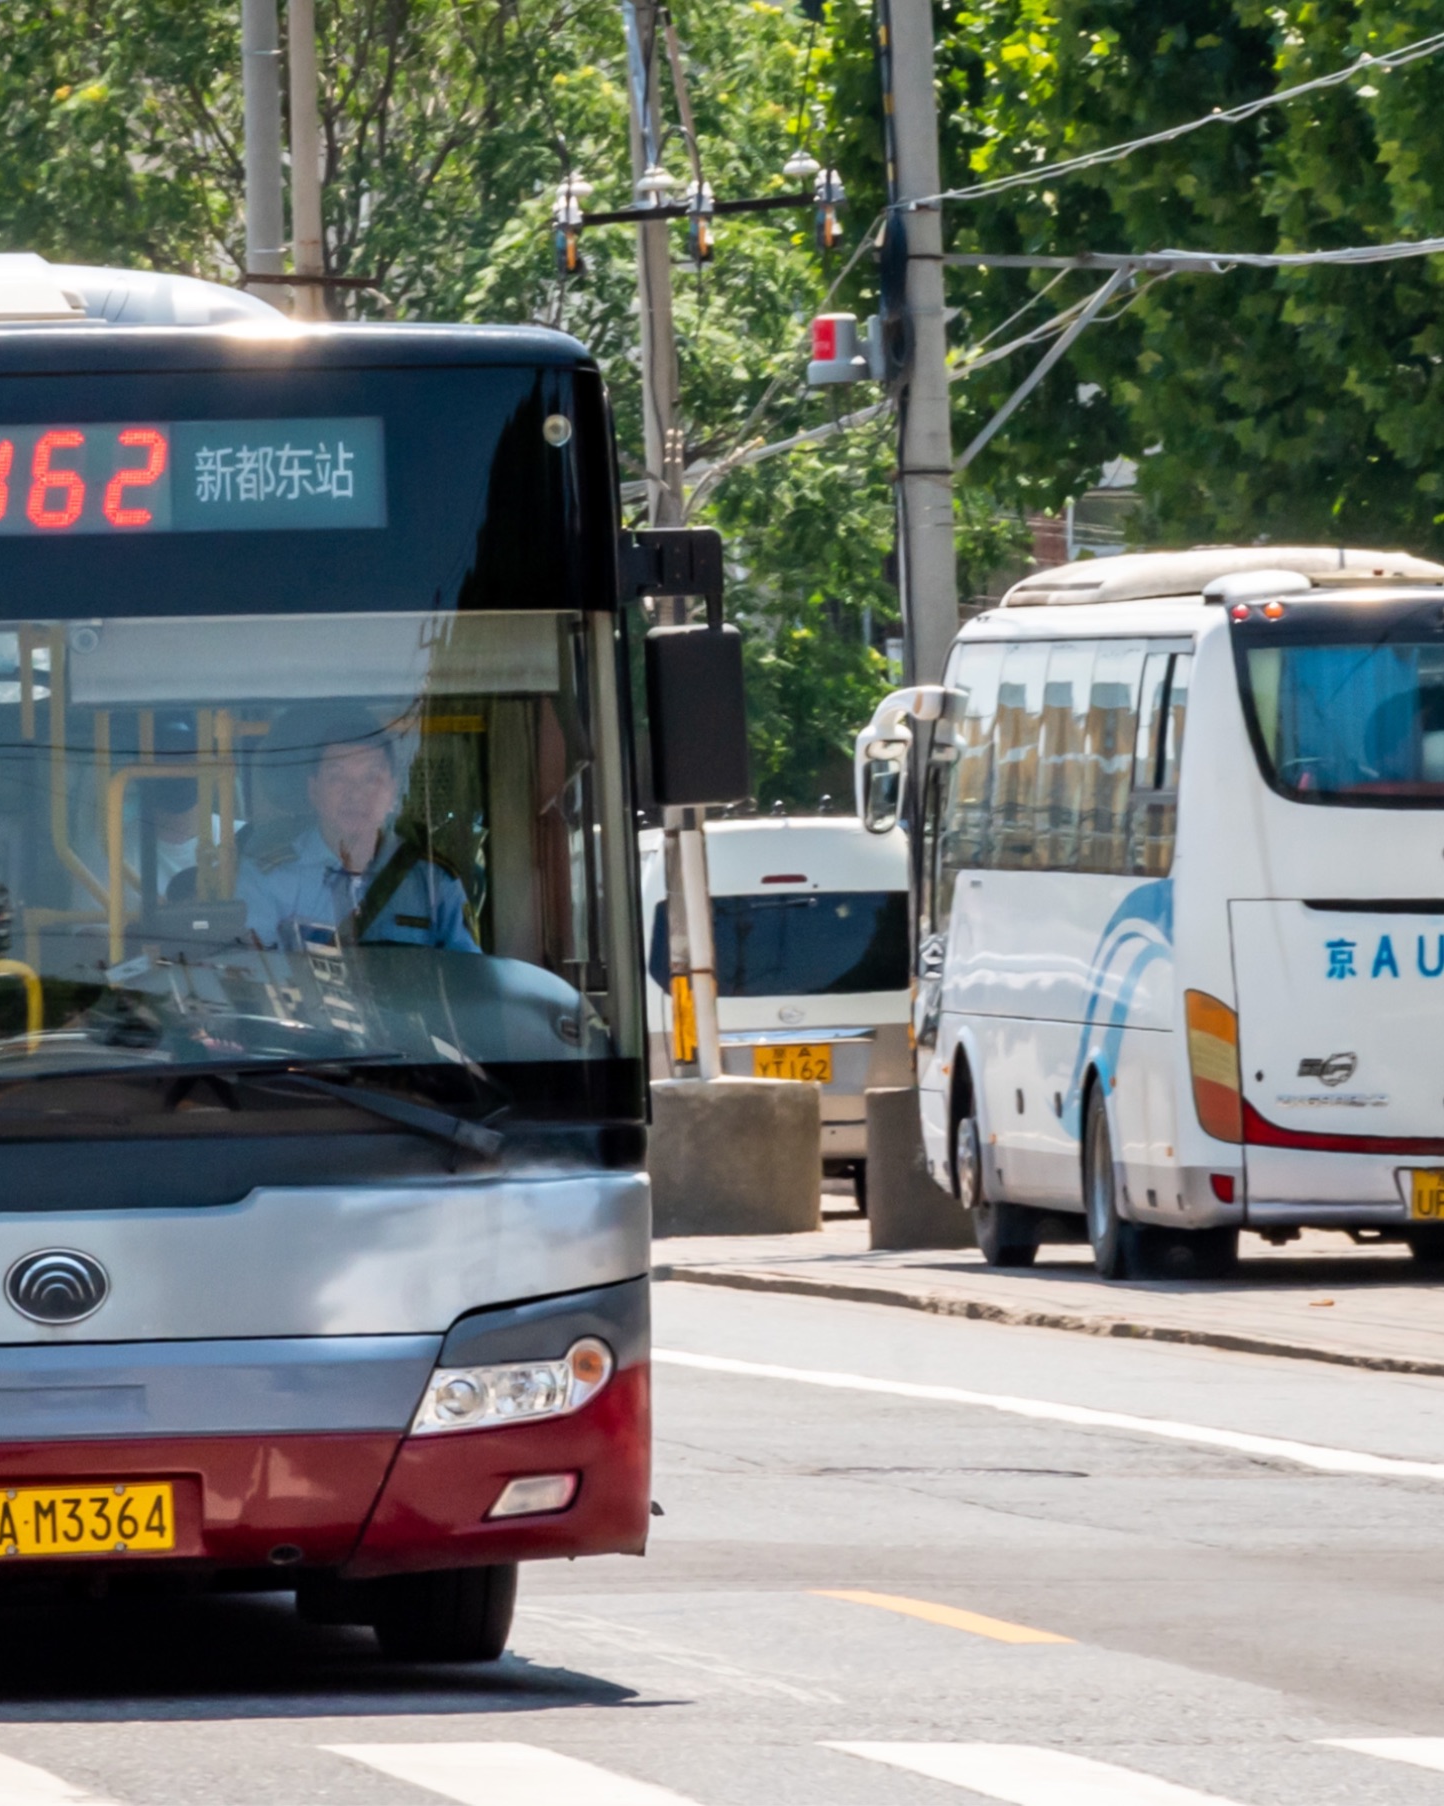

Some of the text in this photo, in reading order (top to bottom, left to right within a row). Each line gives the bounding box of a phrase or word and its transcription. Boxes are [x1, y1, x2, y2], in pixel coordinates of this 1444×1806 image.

[195, 441, 355, 501] 新都东站
[759, 1059, 828, 1080] YT162
